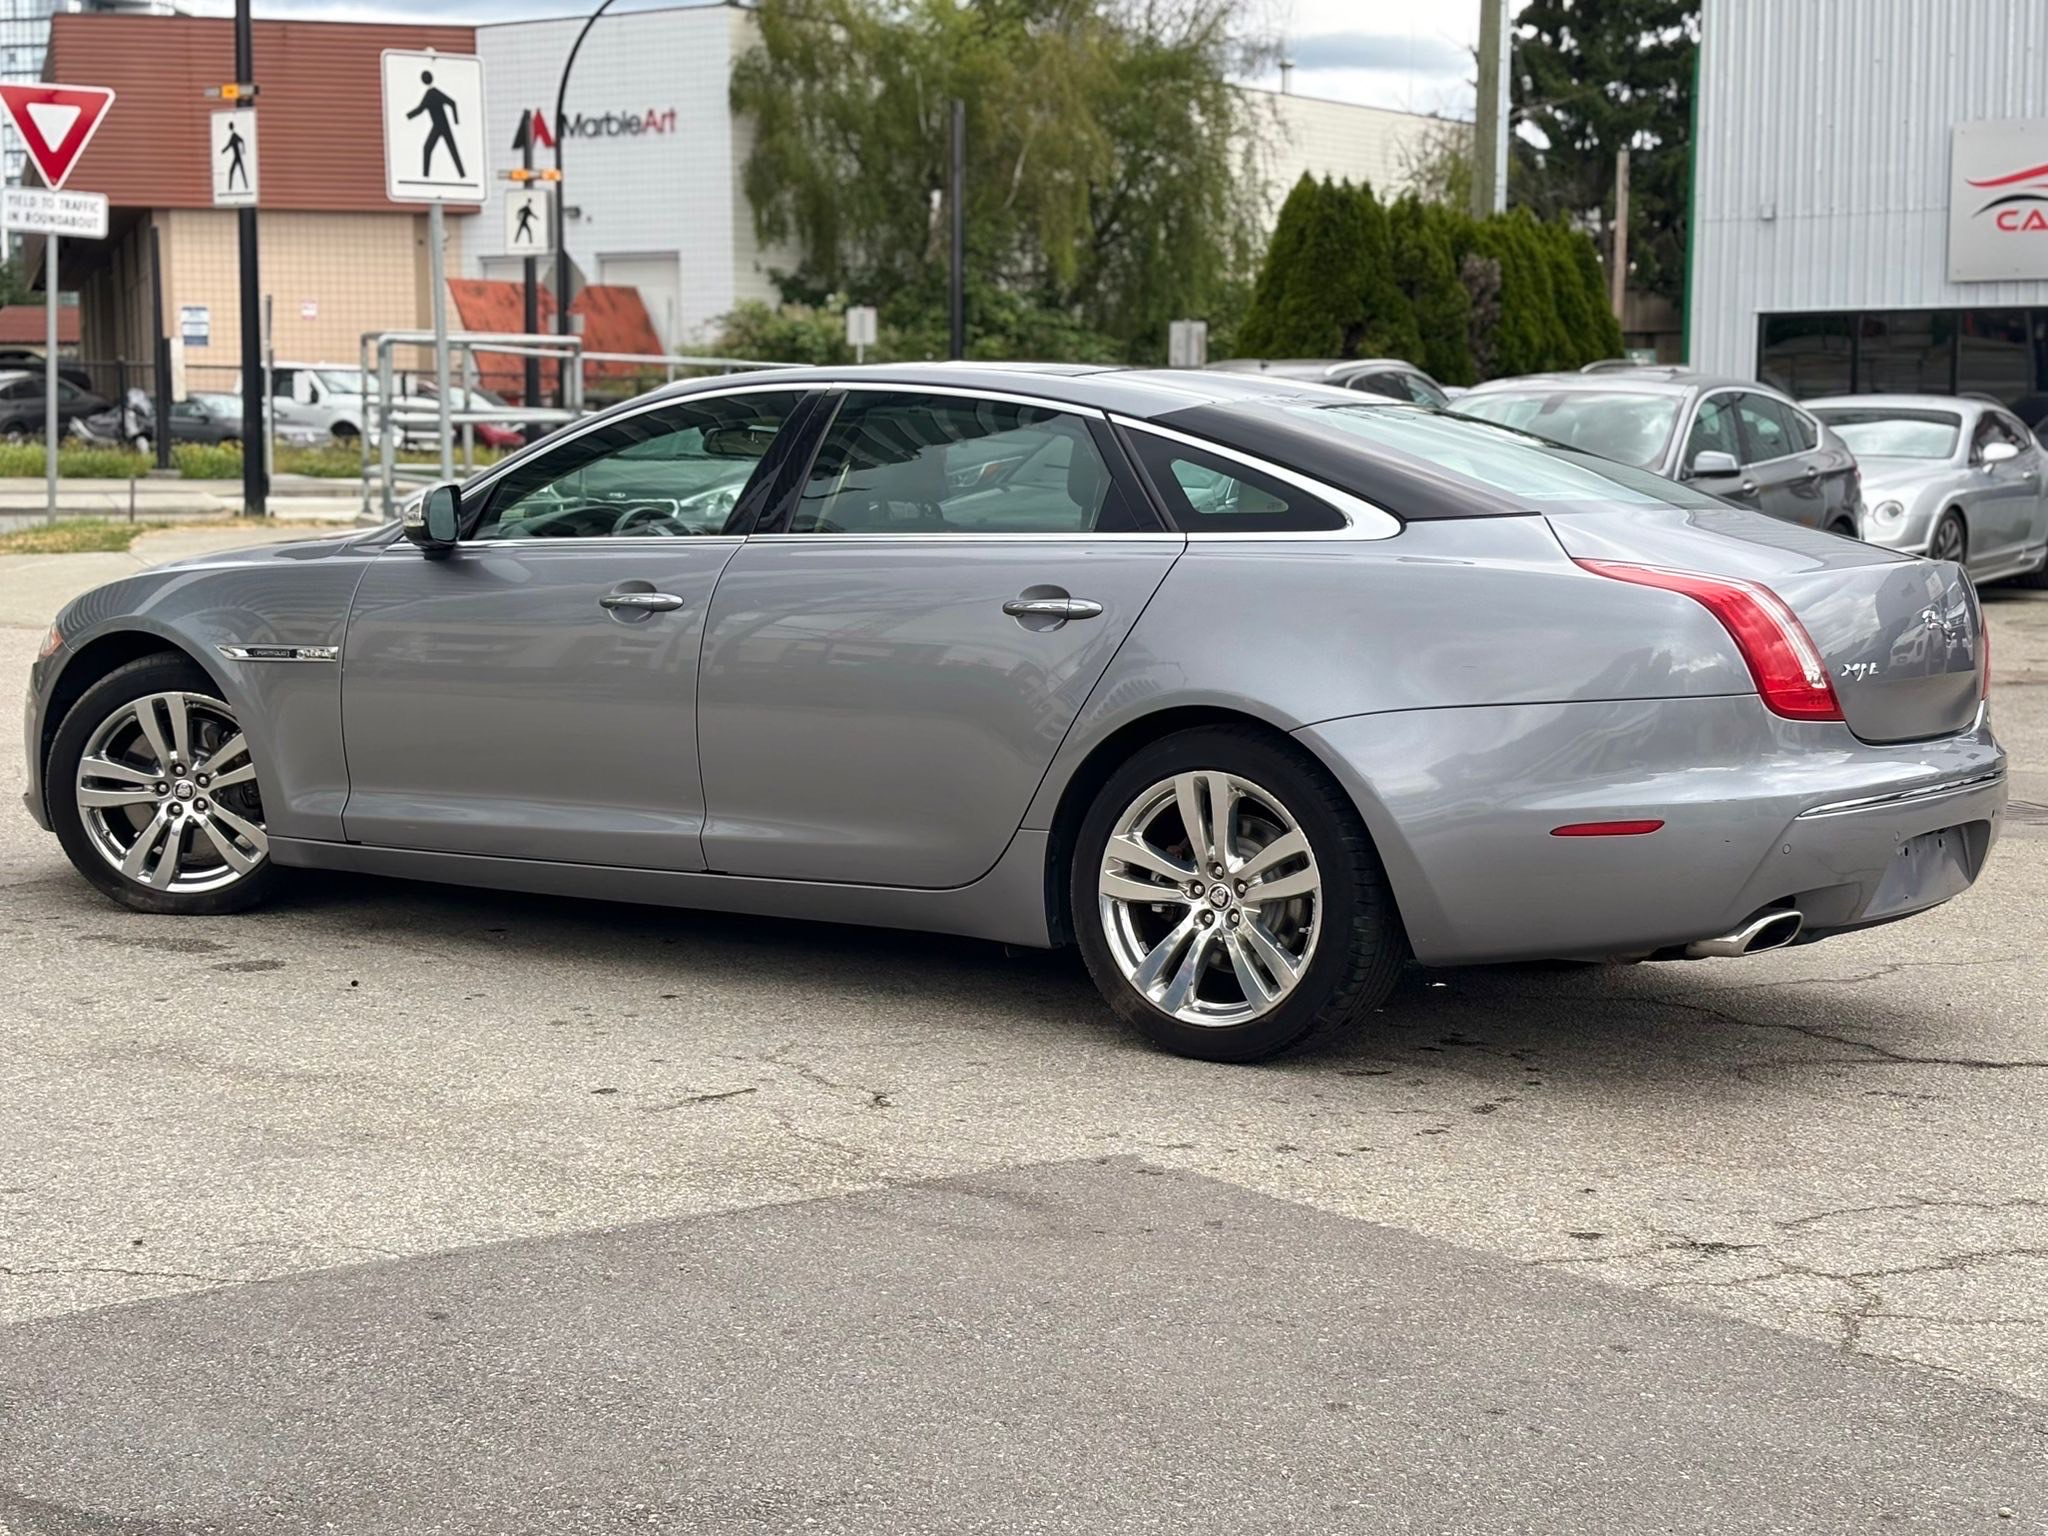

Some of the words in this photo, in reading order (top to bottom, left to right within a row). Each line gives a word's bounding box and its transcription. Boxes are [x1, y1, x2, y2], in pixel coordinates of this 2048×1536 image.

[561, 109, 677, 139] MarbleArt
[8, 195, 37, 207] YIELD
[42, 197, 55, 209] TO
[59, 198, 99, 213] TRAFFIC
[8, 210, 19, 222] IN
[26, 212, 99, 229] ROUNDABOUT
